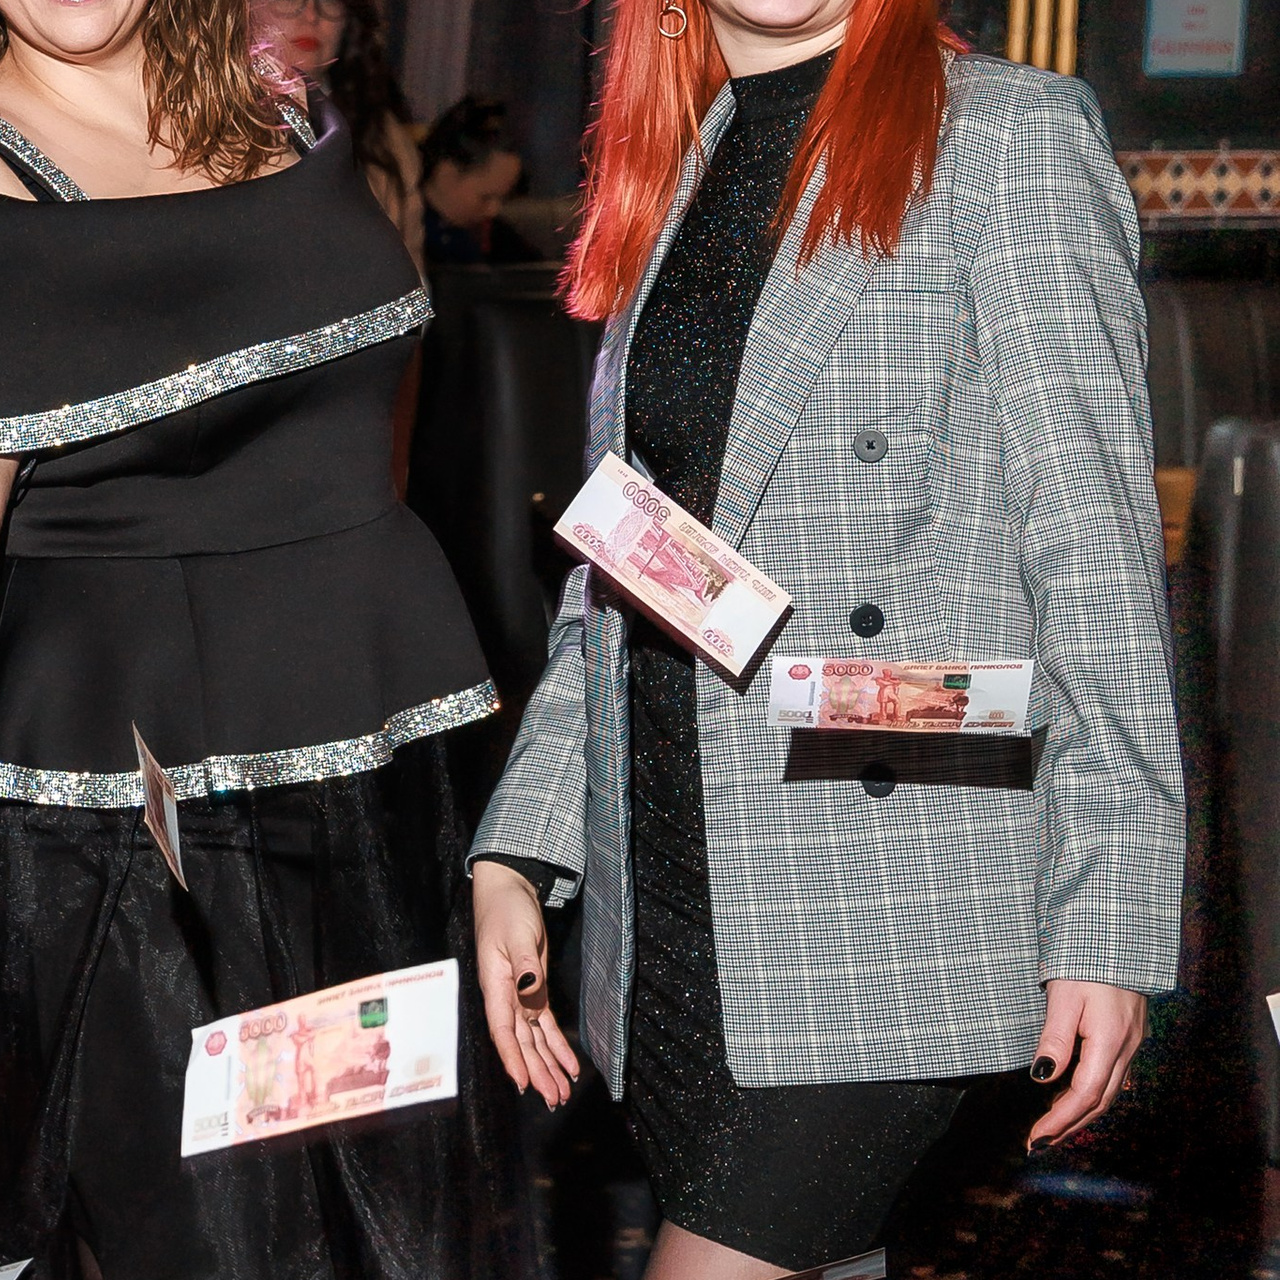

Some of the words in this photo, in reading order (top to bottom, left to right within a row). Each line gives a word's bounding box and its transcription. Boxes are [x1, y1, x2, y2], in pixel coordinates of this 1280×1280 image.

[622, 481, 672, 525] 5000
[573, 524, 603, 552] 5000
[703, 629, 733, 654] 5000
[822, 664, 873, 676] 5000
[969, 663, 1023, 671] ПРИКОЛОВ
[239, 1012, 287, 1041] 5000
